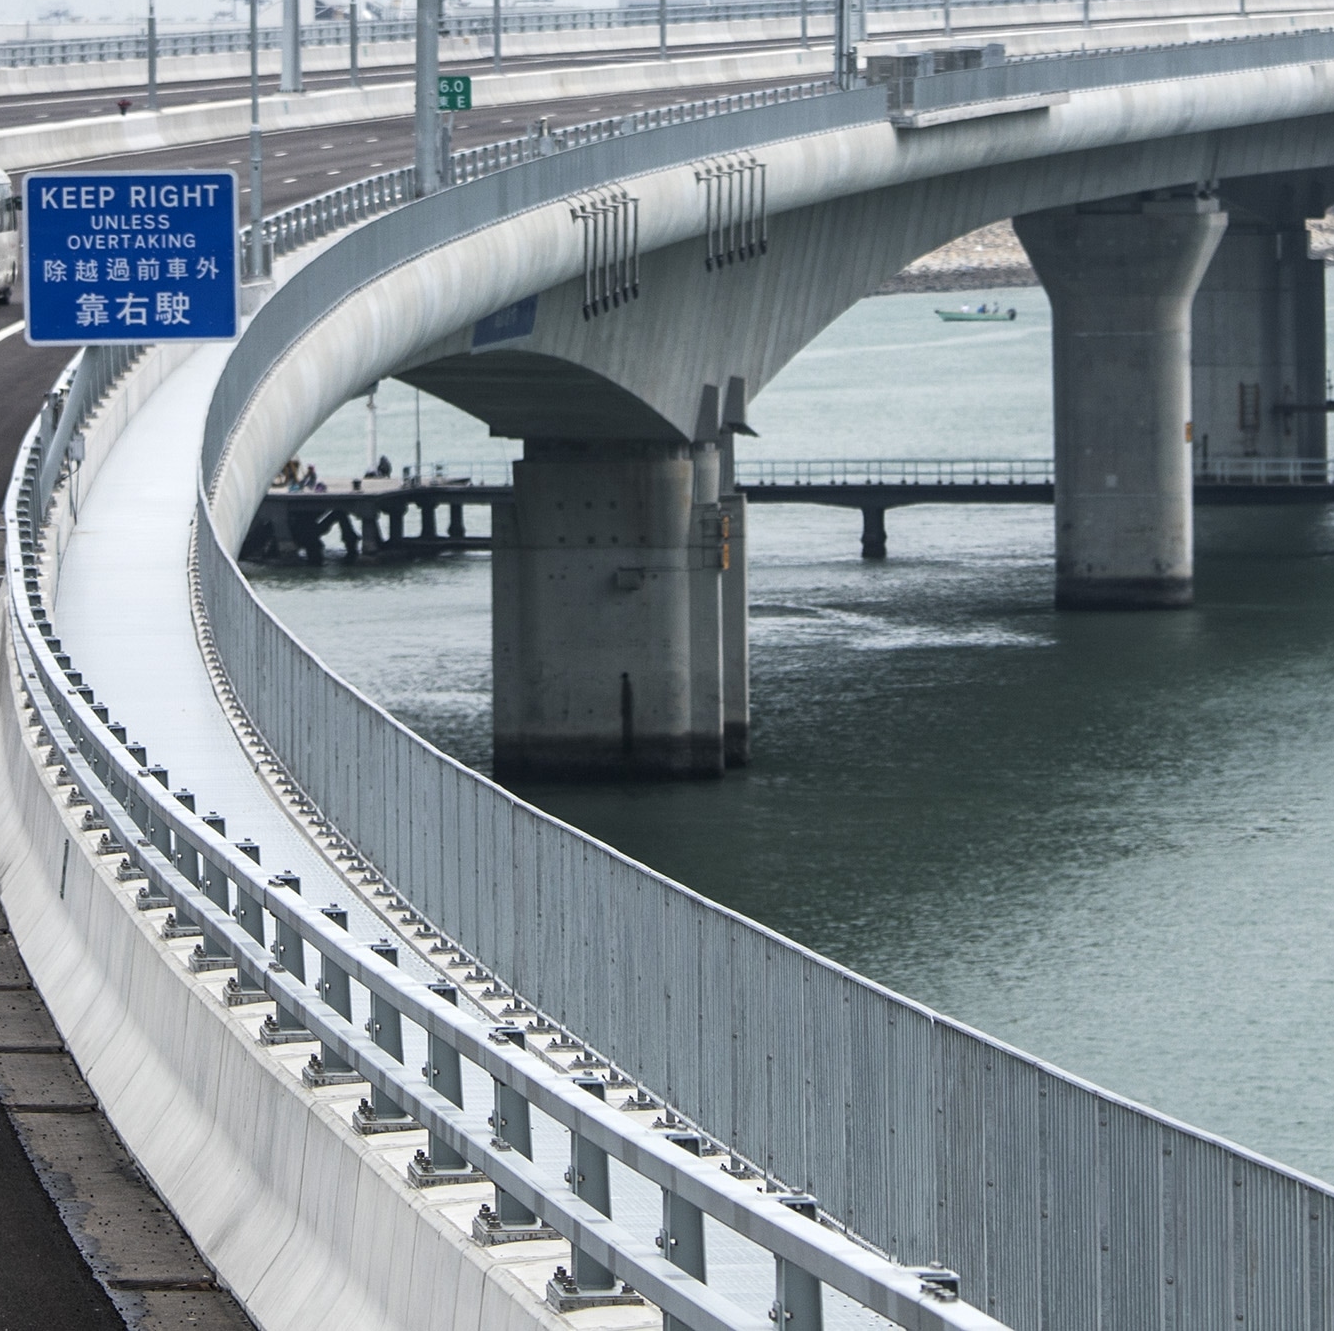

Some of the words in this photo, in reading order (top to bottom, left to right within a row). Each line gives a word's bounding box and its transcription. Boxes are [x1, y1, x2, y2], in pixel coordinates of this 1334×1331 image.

[440, 80, 464, 93] 6.0
[457, 96, 466, 109] E
[41, 186, 115, 209] KEEP
[130, 185, 219, 208] RIGHT
[91, 215, 170, 230] UNLESS
[67, 233, 196, 250] OVERTAKING
[44, 257, 220, 283] 除越過前車外
[76, 292, 191, 327] 靠右駛
